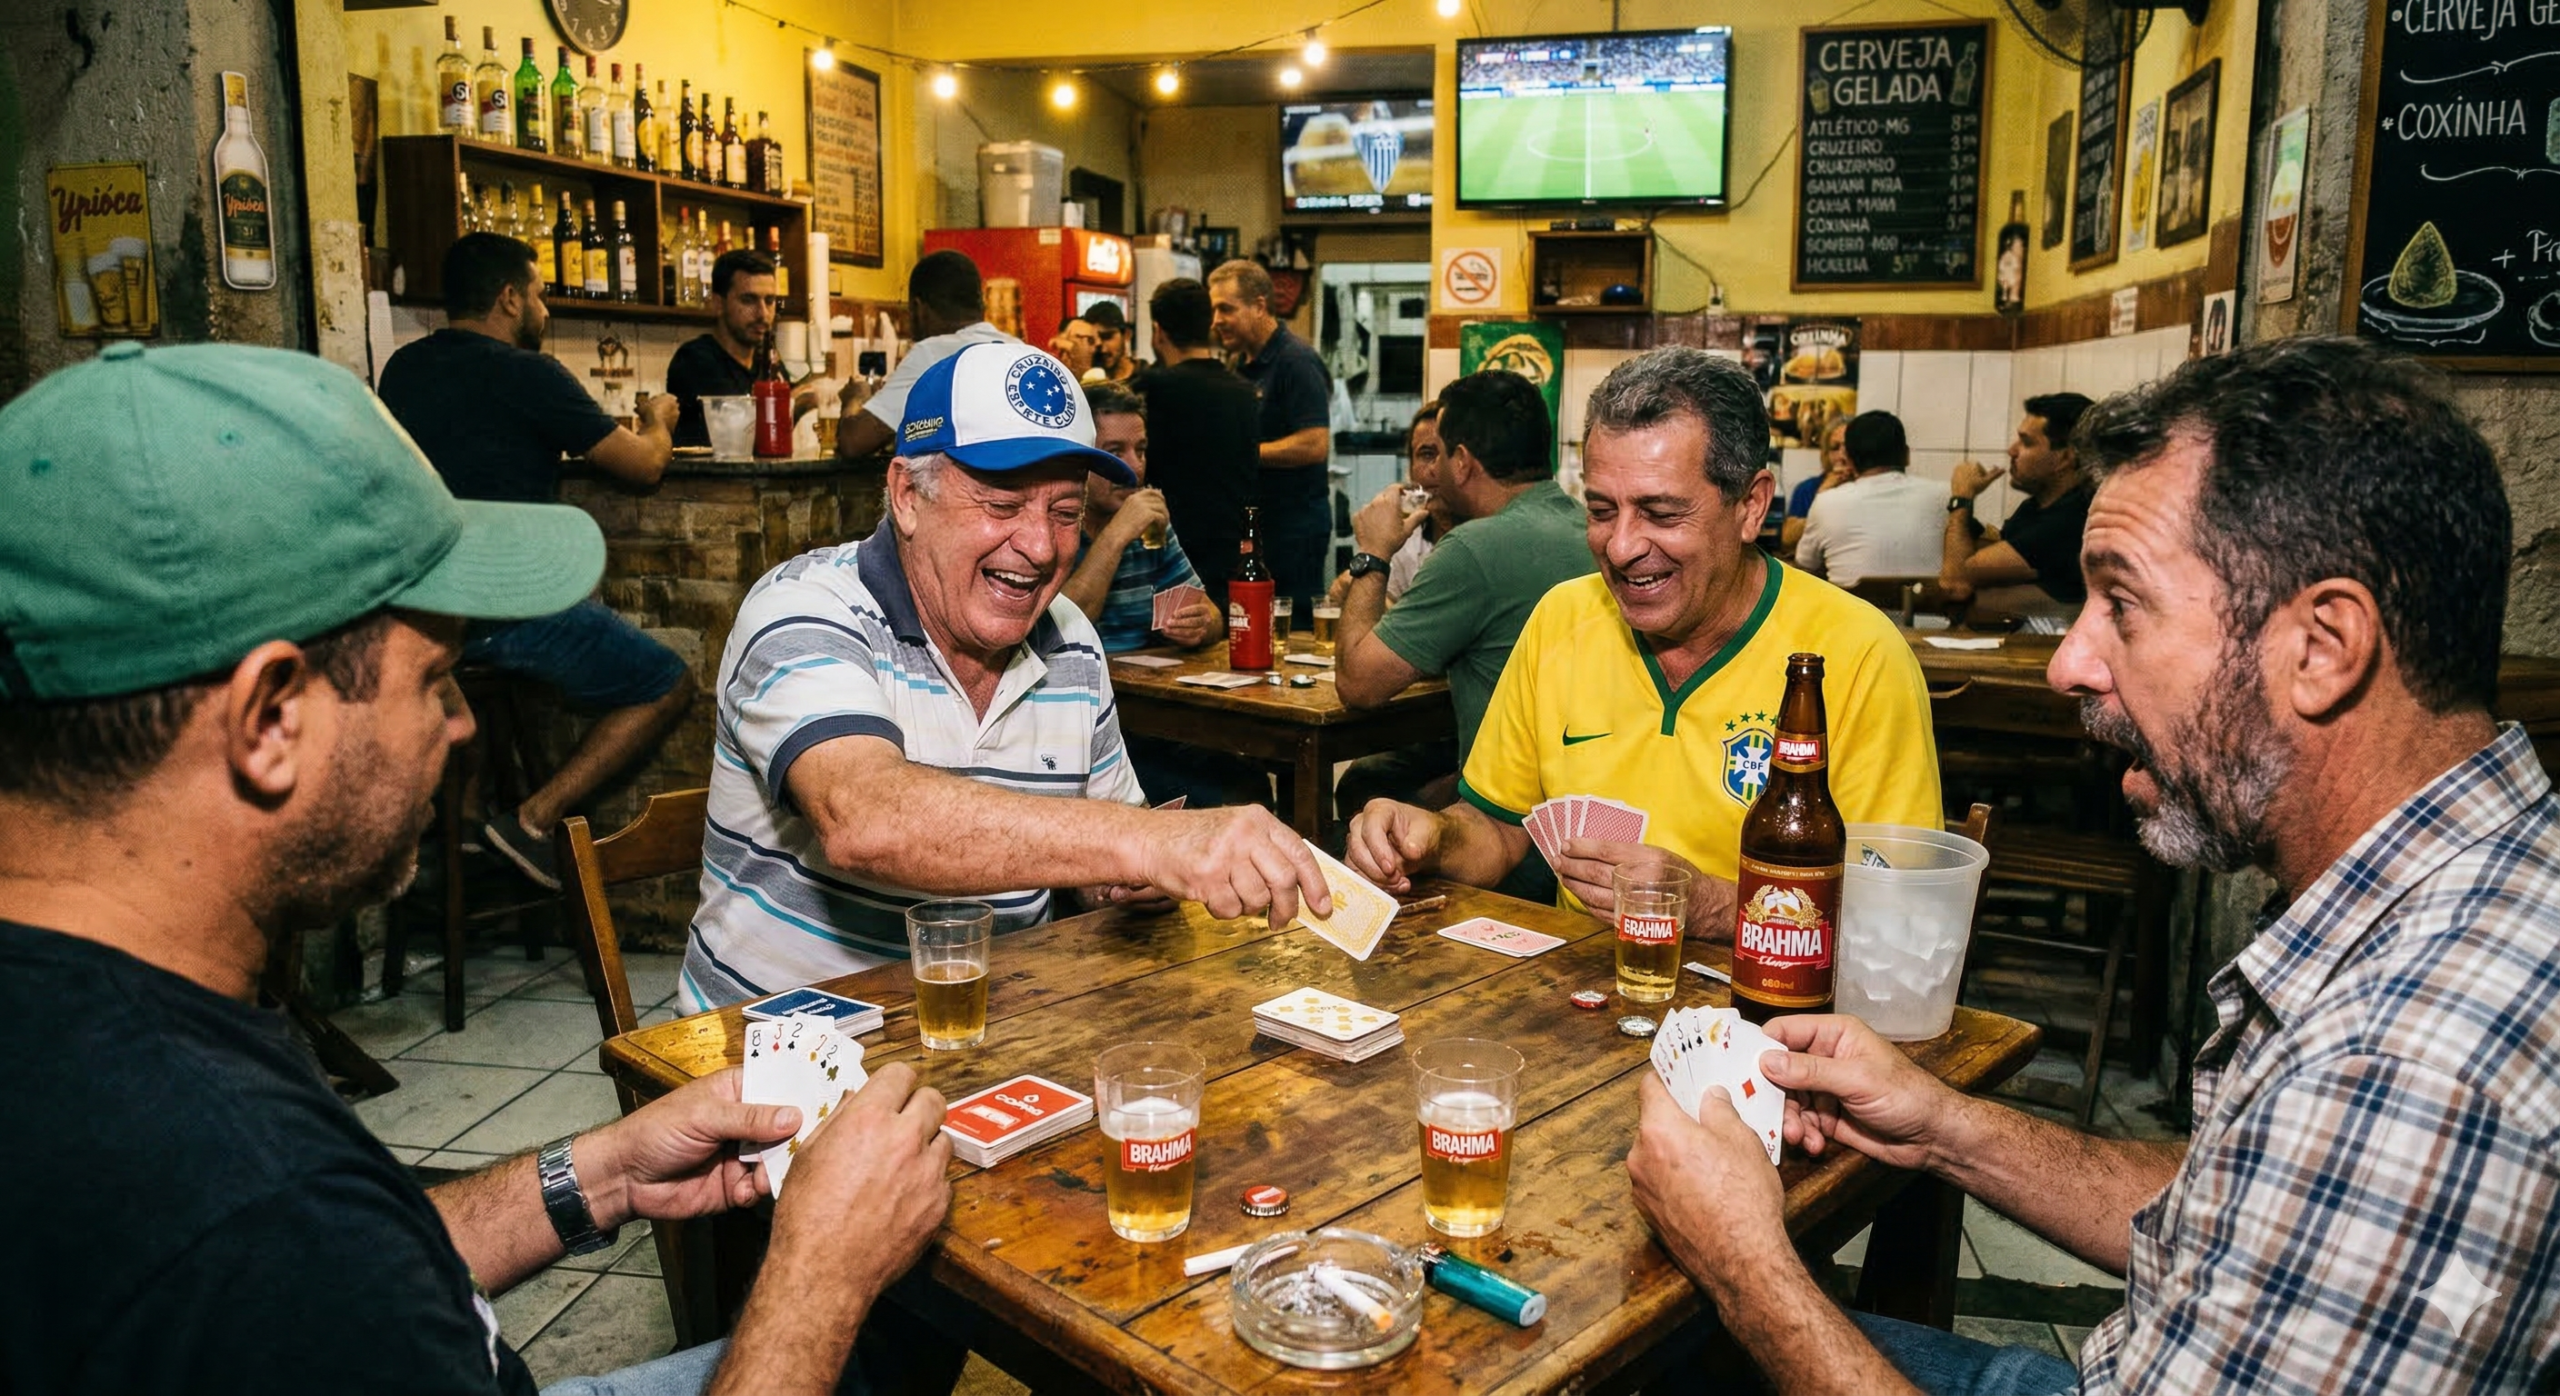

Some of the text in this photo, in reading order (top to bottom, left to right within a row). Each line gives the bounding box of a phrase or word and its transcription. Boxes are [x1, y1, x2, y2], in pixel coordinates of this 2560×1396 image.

[2404, 0, 2516, 41] CERVEJA
[1819, 37, 1953, 72] CERVEJA
[1833, 73, 1942, 106] GELADA
[1808, 138, 1883, 156] CRUZEIRO
[51, 183, 144, 234] Ypióca
[1806, 216, 1871, 234] COXINHA
[1742, 760, 1764, 771] CBF
[1741, 921, 1823, 958] BRAHMA
[791, 1022, 804, 1039] 2
[1129, 1132, 1193, 1164] BRAHMA
[1431, 1129, 1496, 1156] BRAHMA
